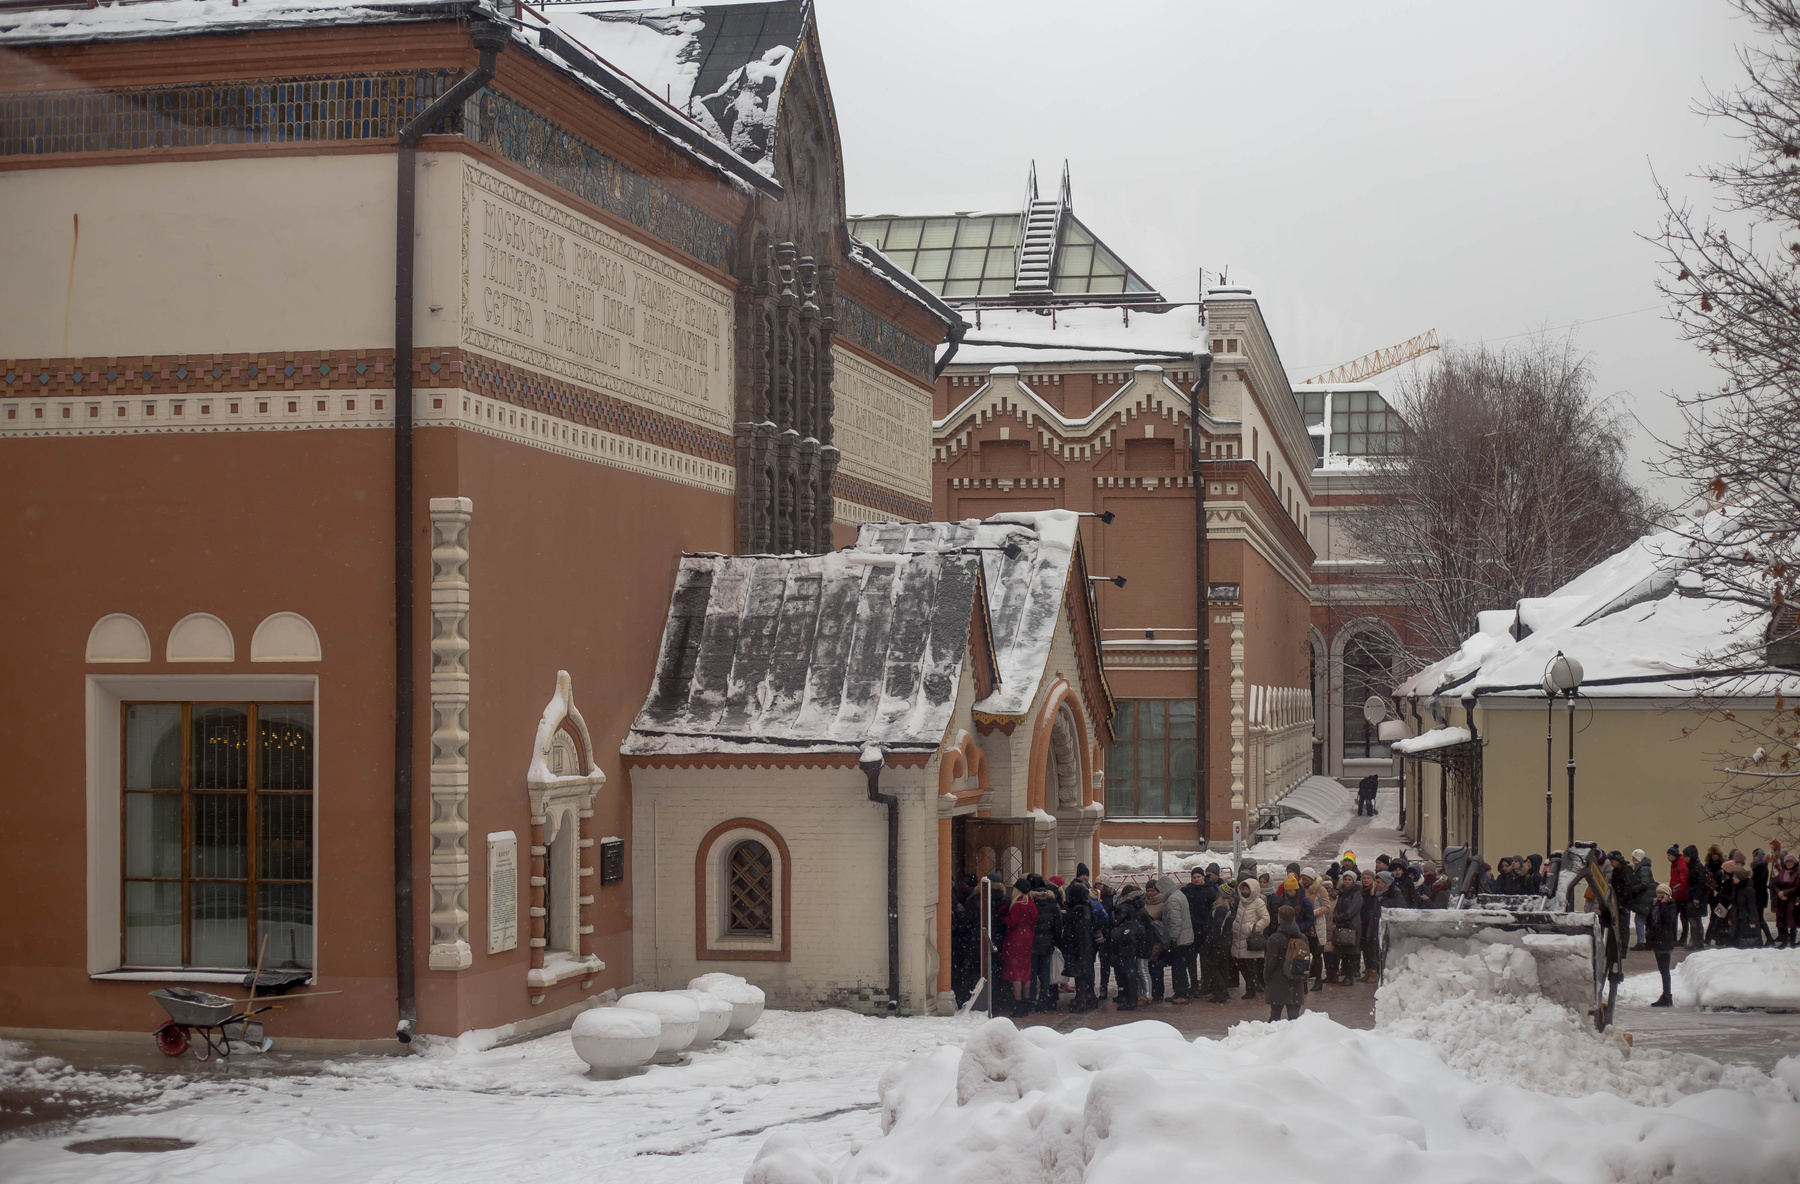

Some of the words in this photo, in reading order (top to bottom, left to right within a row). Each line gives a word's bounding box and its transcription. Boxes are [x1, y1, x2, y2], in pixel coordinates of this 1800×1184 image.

[543, 309, 620, 370] МИХАЙЛОВИЧА
[556, 274, 595, 322] ИМЕНИ
[602, 294, 635, 338] ПАВЛА
[642, 311, 708, 368] МИХАЙЛОВИЧА
